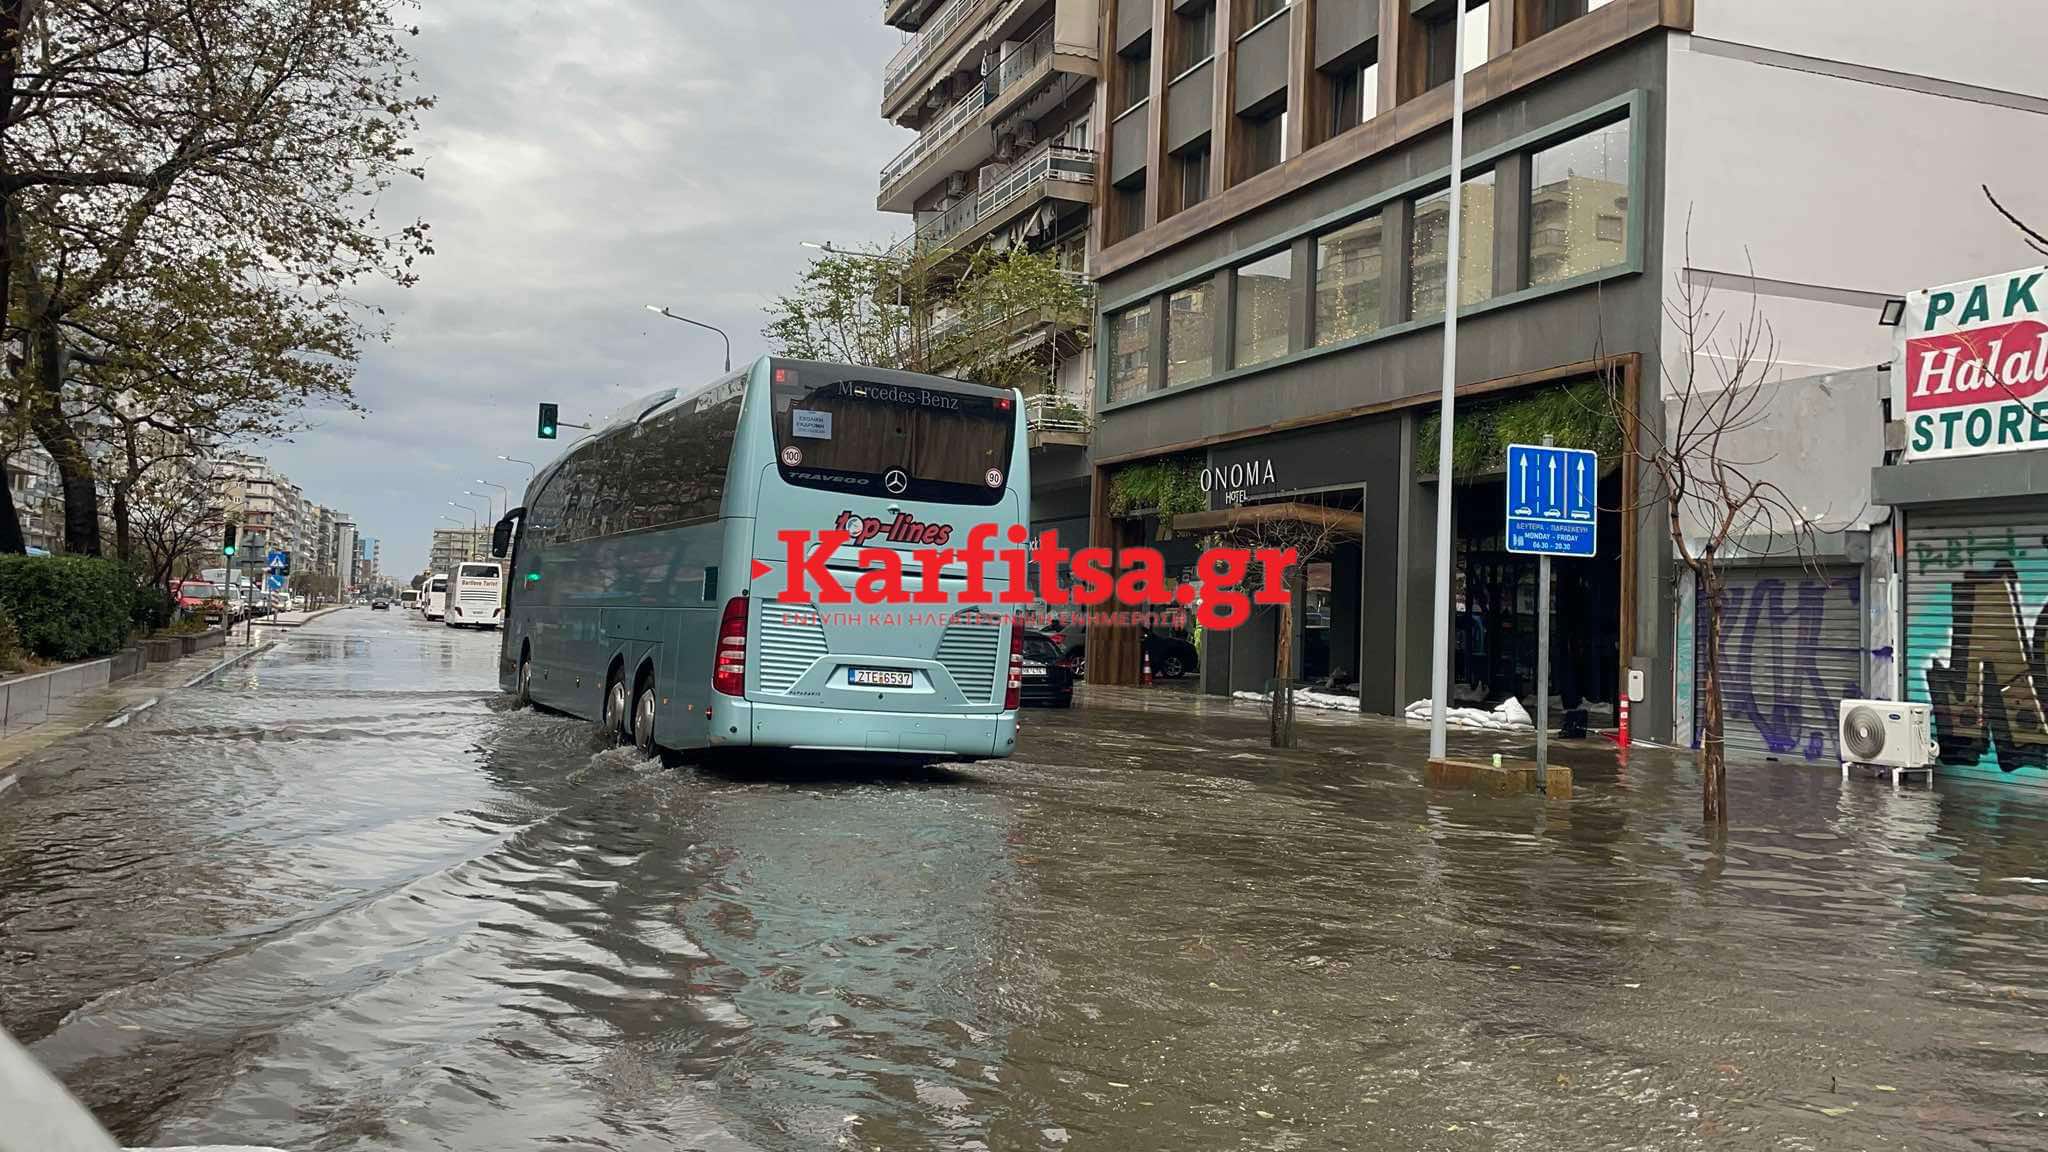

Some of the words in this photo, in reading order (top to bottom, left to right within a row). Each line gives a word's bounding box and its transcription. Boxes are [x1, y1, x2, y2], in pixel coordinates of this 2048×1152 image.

[1924, 272, 2044, 331] PAK
[1912, 330, 2048, 397] Halal
[838, 380, 960, 410] Mercedes-Benz
[1912, 401, 2048, 453] STORE
[785, 451, 799, 462] 100
[788, 471, 870, 485] TRAVEGO
[990, 473, 999, 483] 90
[1200, 459, 1275, 491] ONOMA
[1225, 489, 1249, 505] HOTEL
[835, 510, 953, 546] top-lines
[1524, 532, 1550, 540] MONDAY
[1556, 534, 1579, 542] FRIDAY
